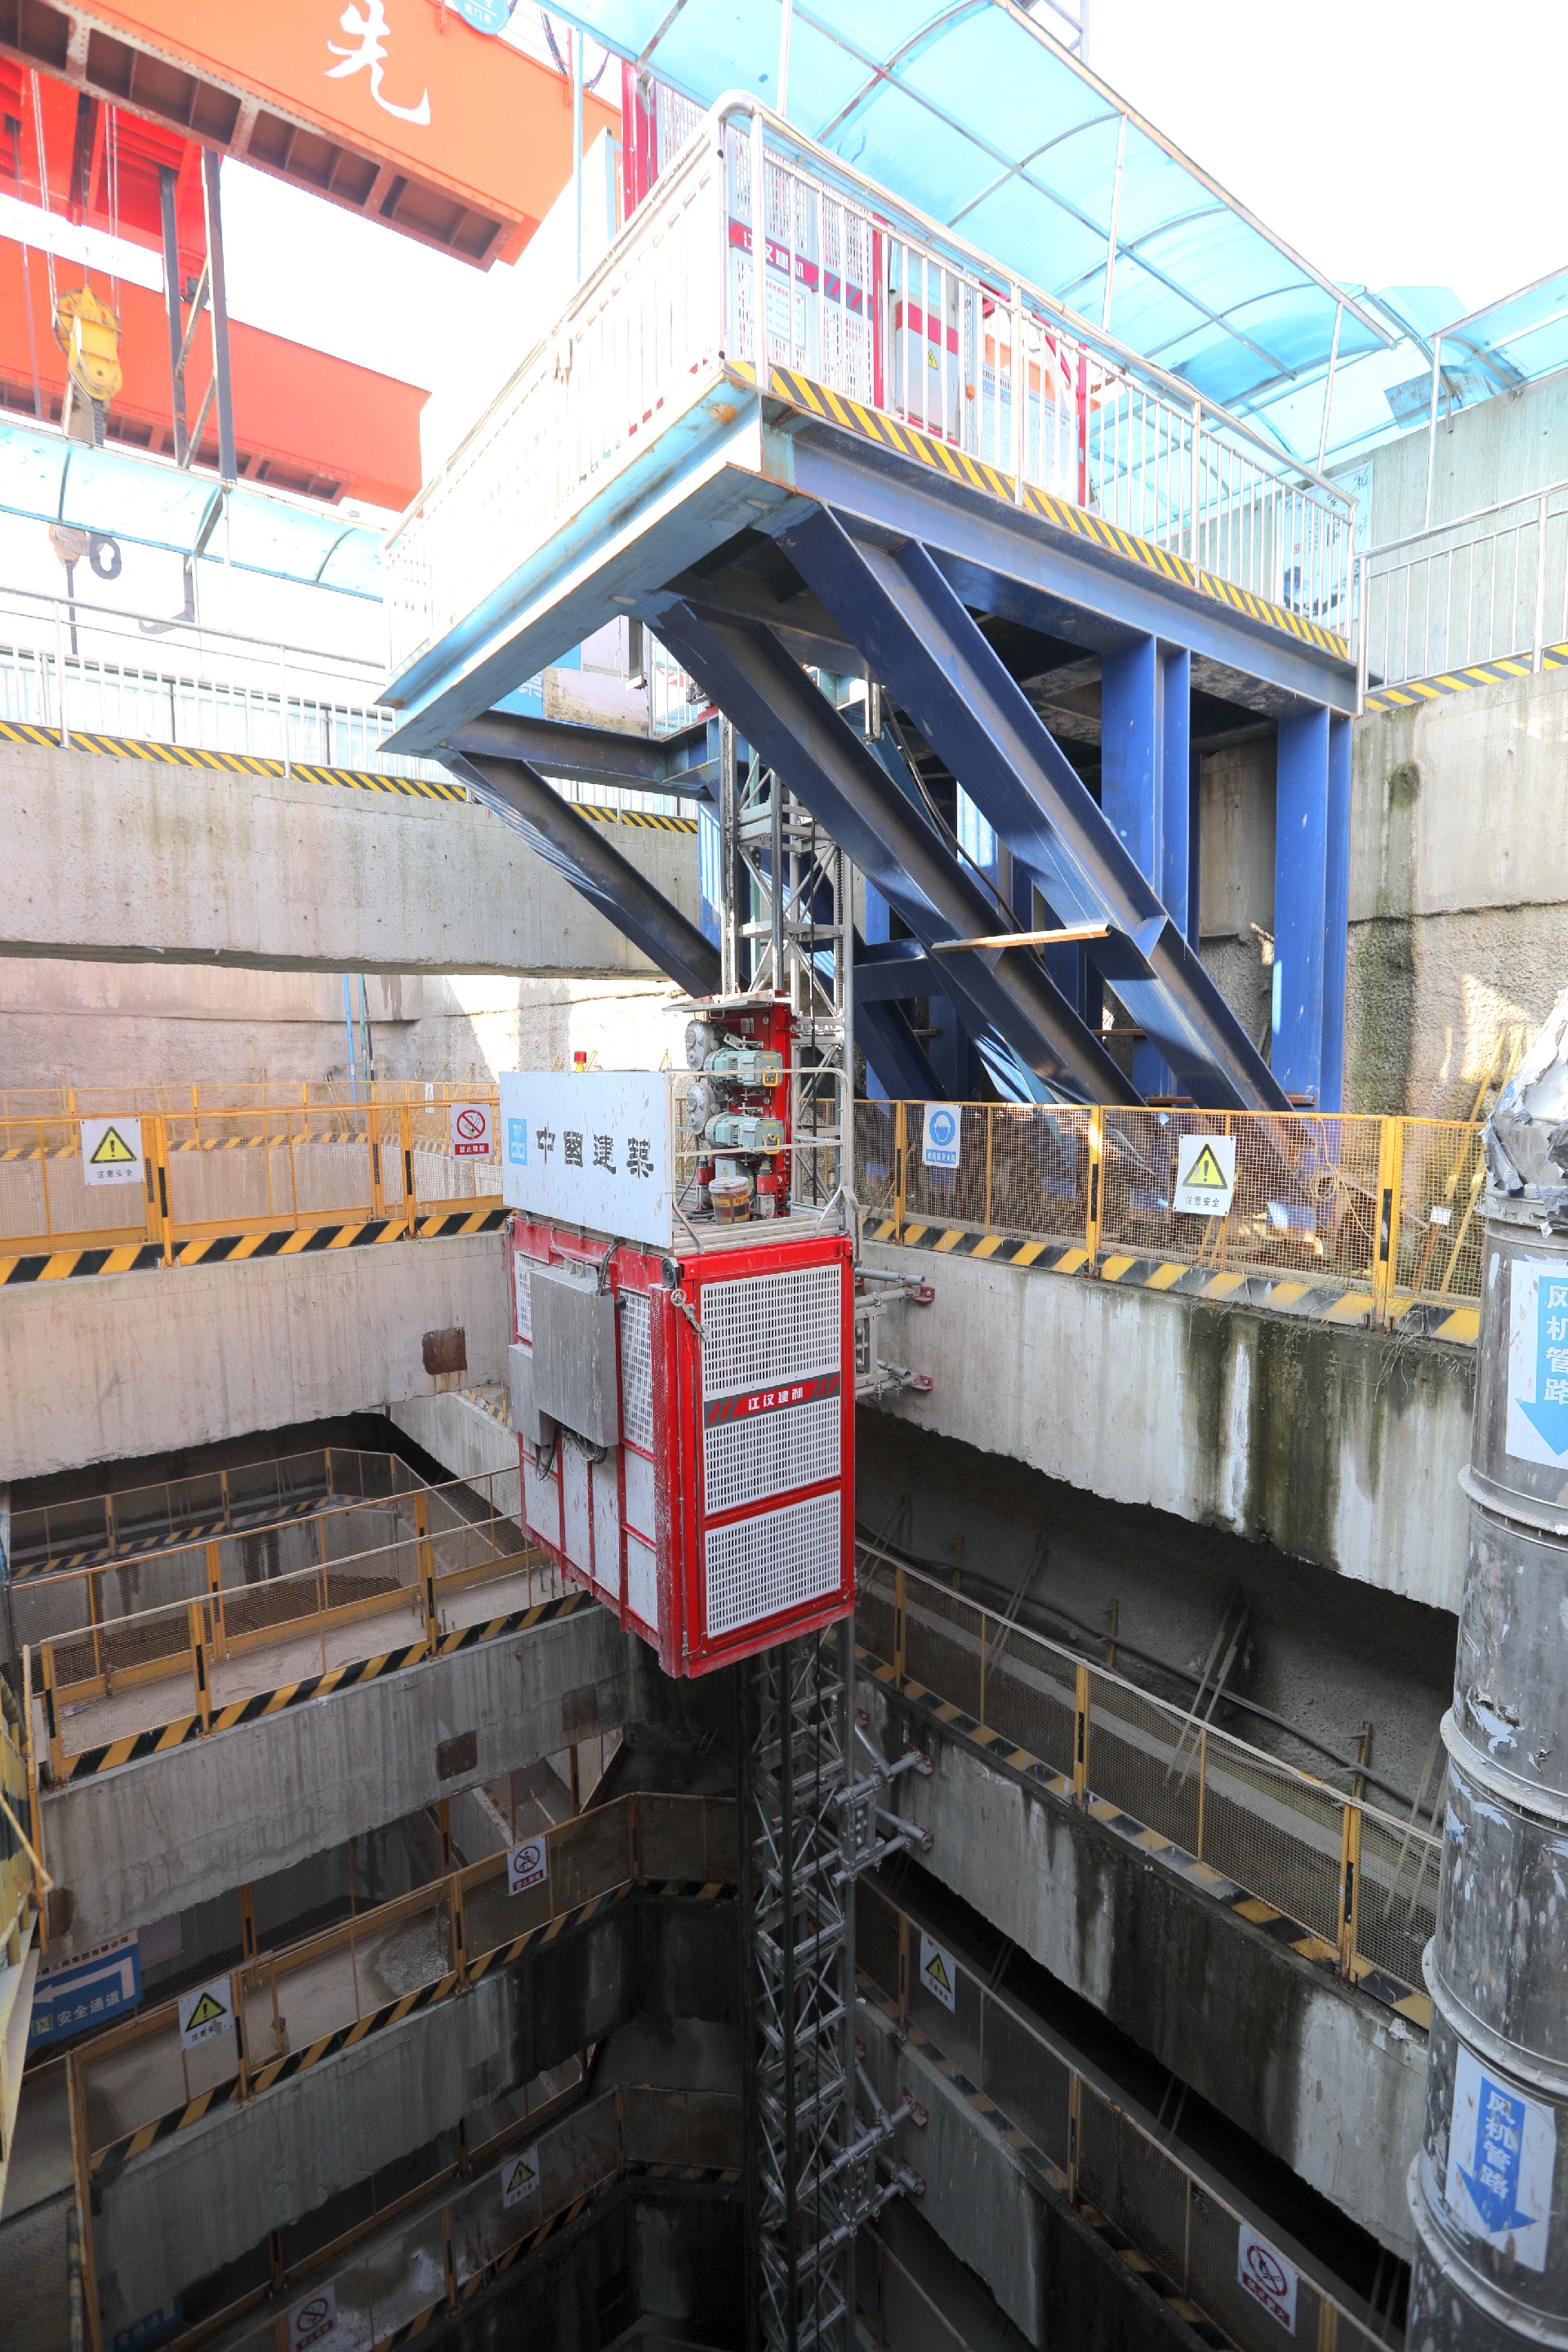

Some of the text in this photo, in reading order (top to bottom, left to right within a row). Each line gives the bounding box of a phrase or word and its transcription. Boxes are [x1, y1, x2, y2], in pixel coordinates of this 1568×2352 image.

[459, 1145, 485, 1154] 禁止吸烟
[97, 1169, 132, 1178] 注意安全
[1185, 1196, 1219, 1208] 注意安全
[748, 1387, 803, 1411] 江汉建机
[56, 1989, 121, 2027] 安全通道
[1480, 2090, 1518, 2200] 风机管路
